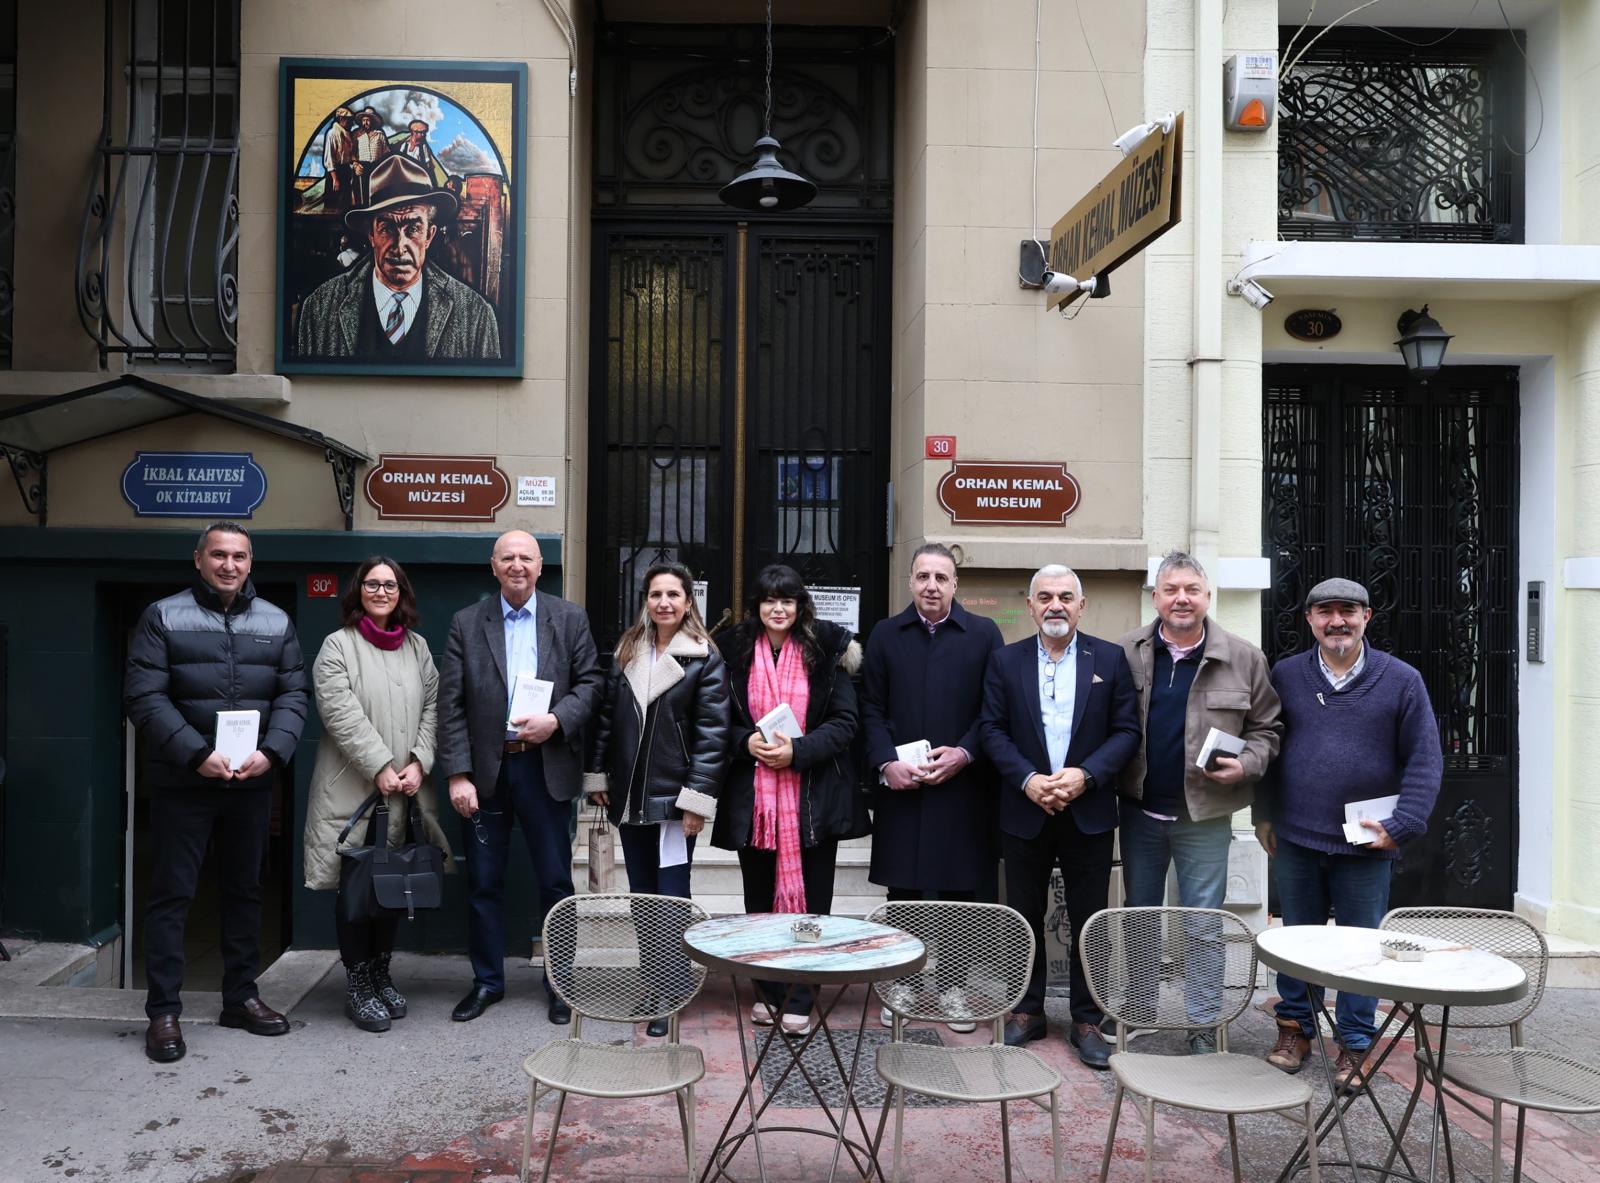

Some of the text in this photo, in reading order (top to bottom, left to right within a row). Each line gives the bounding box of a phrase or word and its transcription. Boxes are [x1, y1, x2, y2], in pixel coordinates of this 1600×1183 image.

[1052, 133, 1165, 275] ORHAN KEMAL MÜZESİ
[1306, 321, 1324, 337] 30
[934, 440, 949, 454] 30
[143, 464, 245, 482] İKBAL KAHVESİ
[382, 472, 493, 485] ORHAN KEMAL
[525, 478, 548, 487] MÜZE
[955, 478, 1063, 491] ORHAN KEMAL
[156, 488, 231, 504] OK KİTABEVİ
[408, 489, 465, 503] MÜZESİ
[976, 496, 1042, 508] MUSEUM
